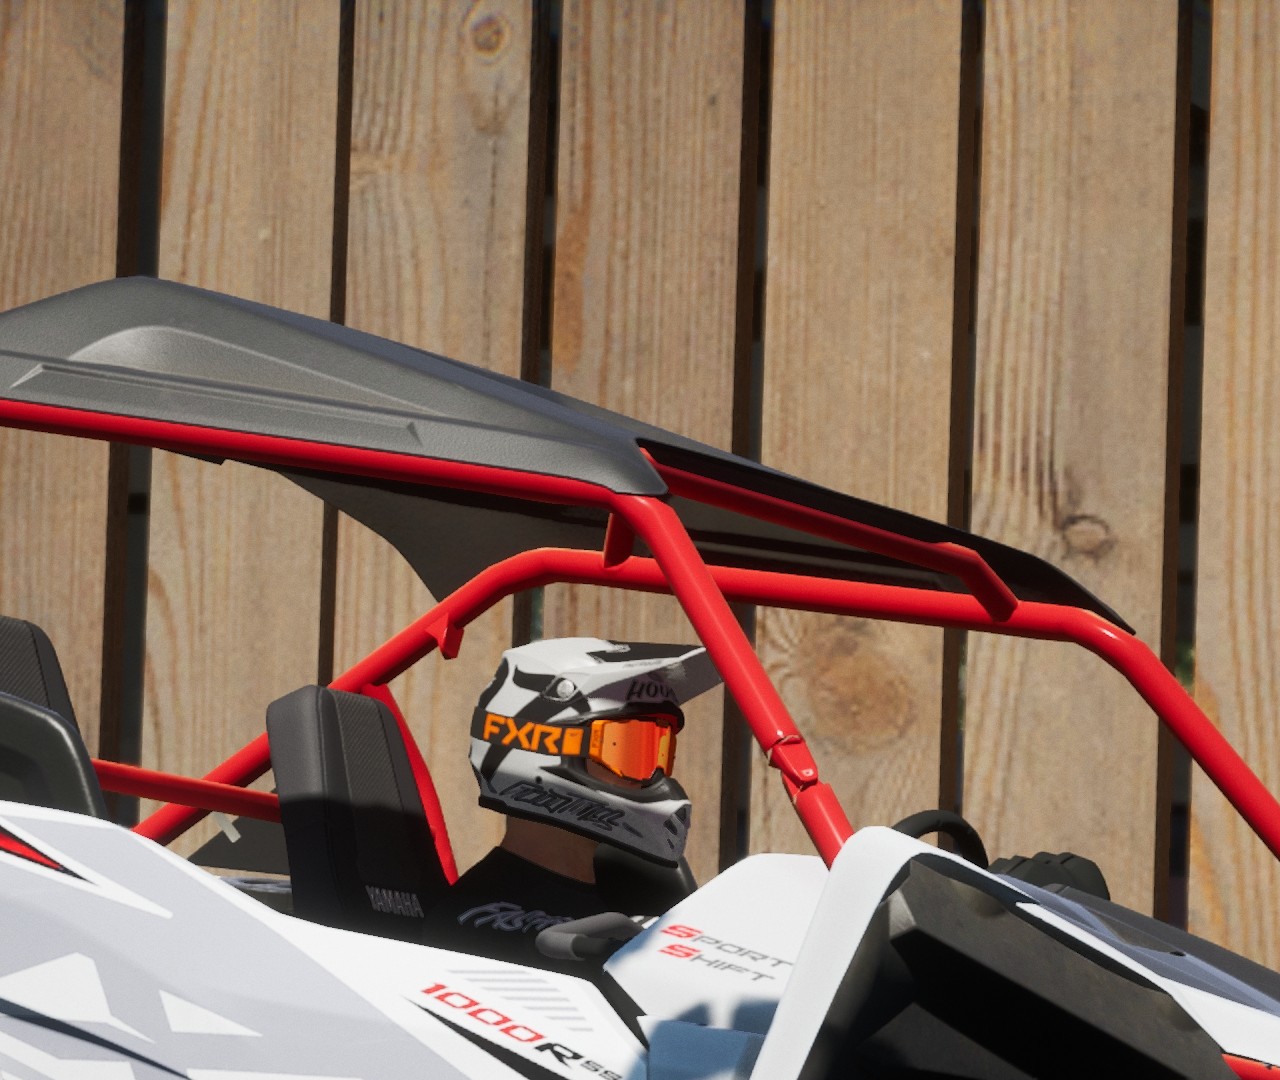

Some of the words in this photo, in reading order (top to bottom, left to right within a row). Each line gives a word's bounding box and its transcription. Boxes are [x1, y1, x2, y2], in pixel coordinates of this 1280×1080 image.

[483, 712, 562, 755] FXR
[365, 885, 424, 918] YAMAHA
[658, 944, 776, 981] SHIFT
[660, 924, 794, 967] SPORT
